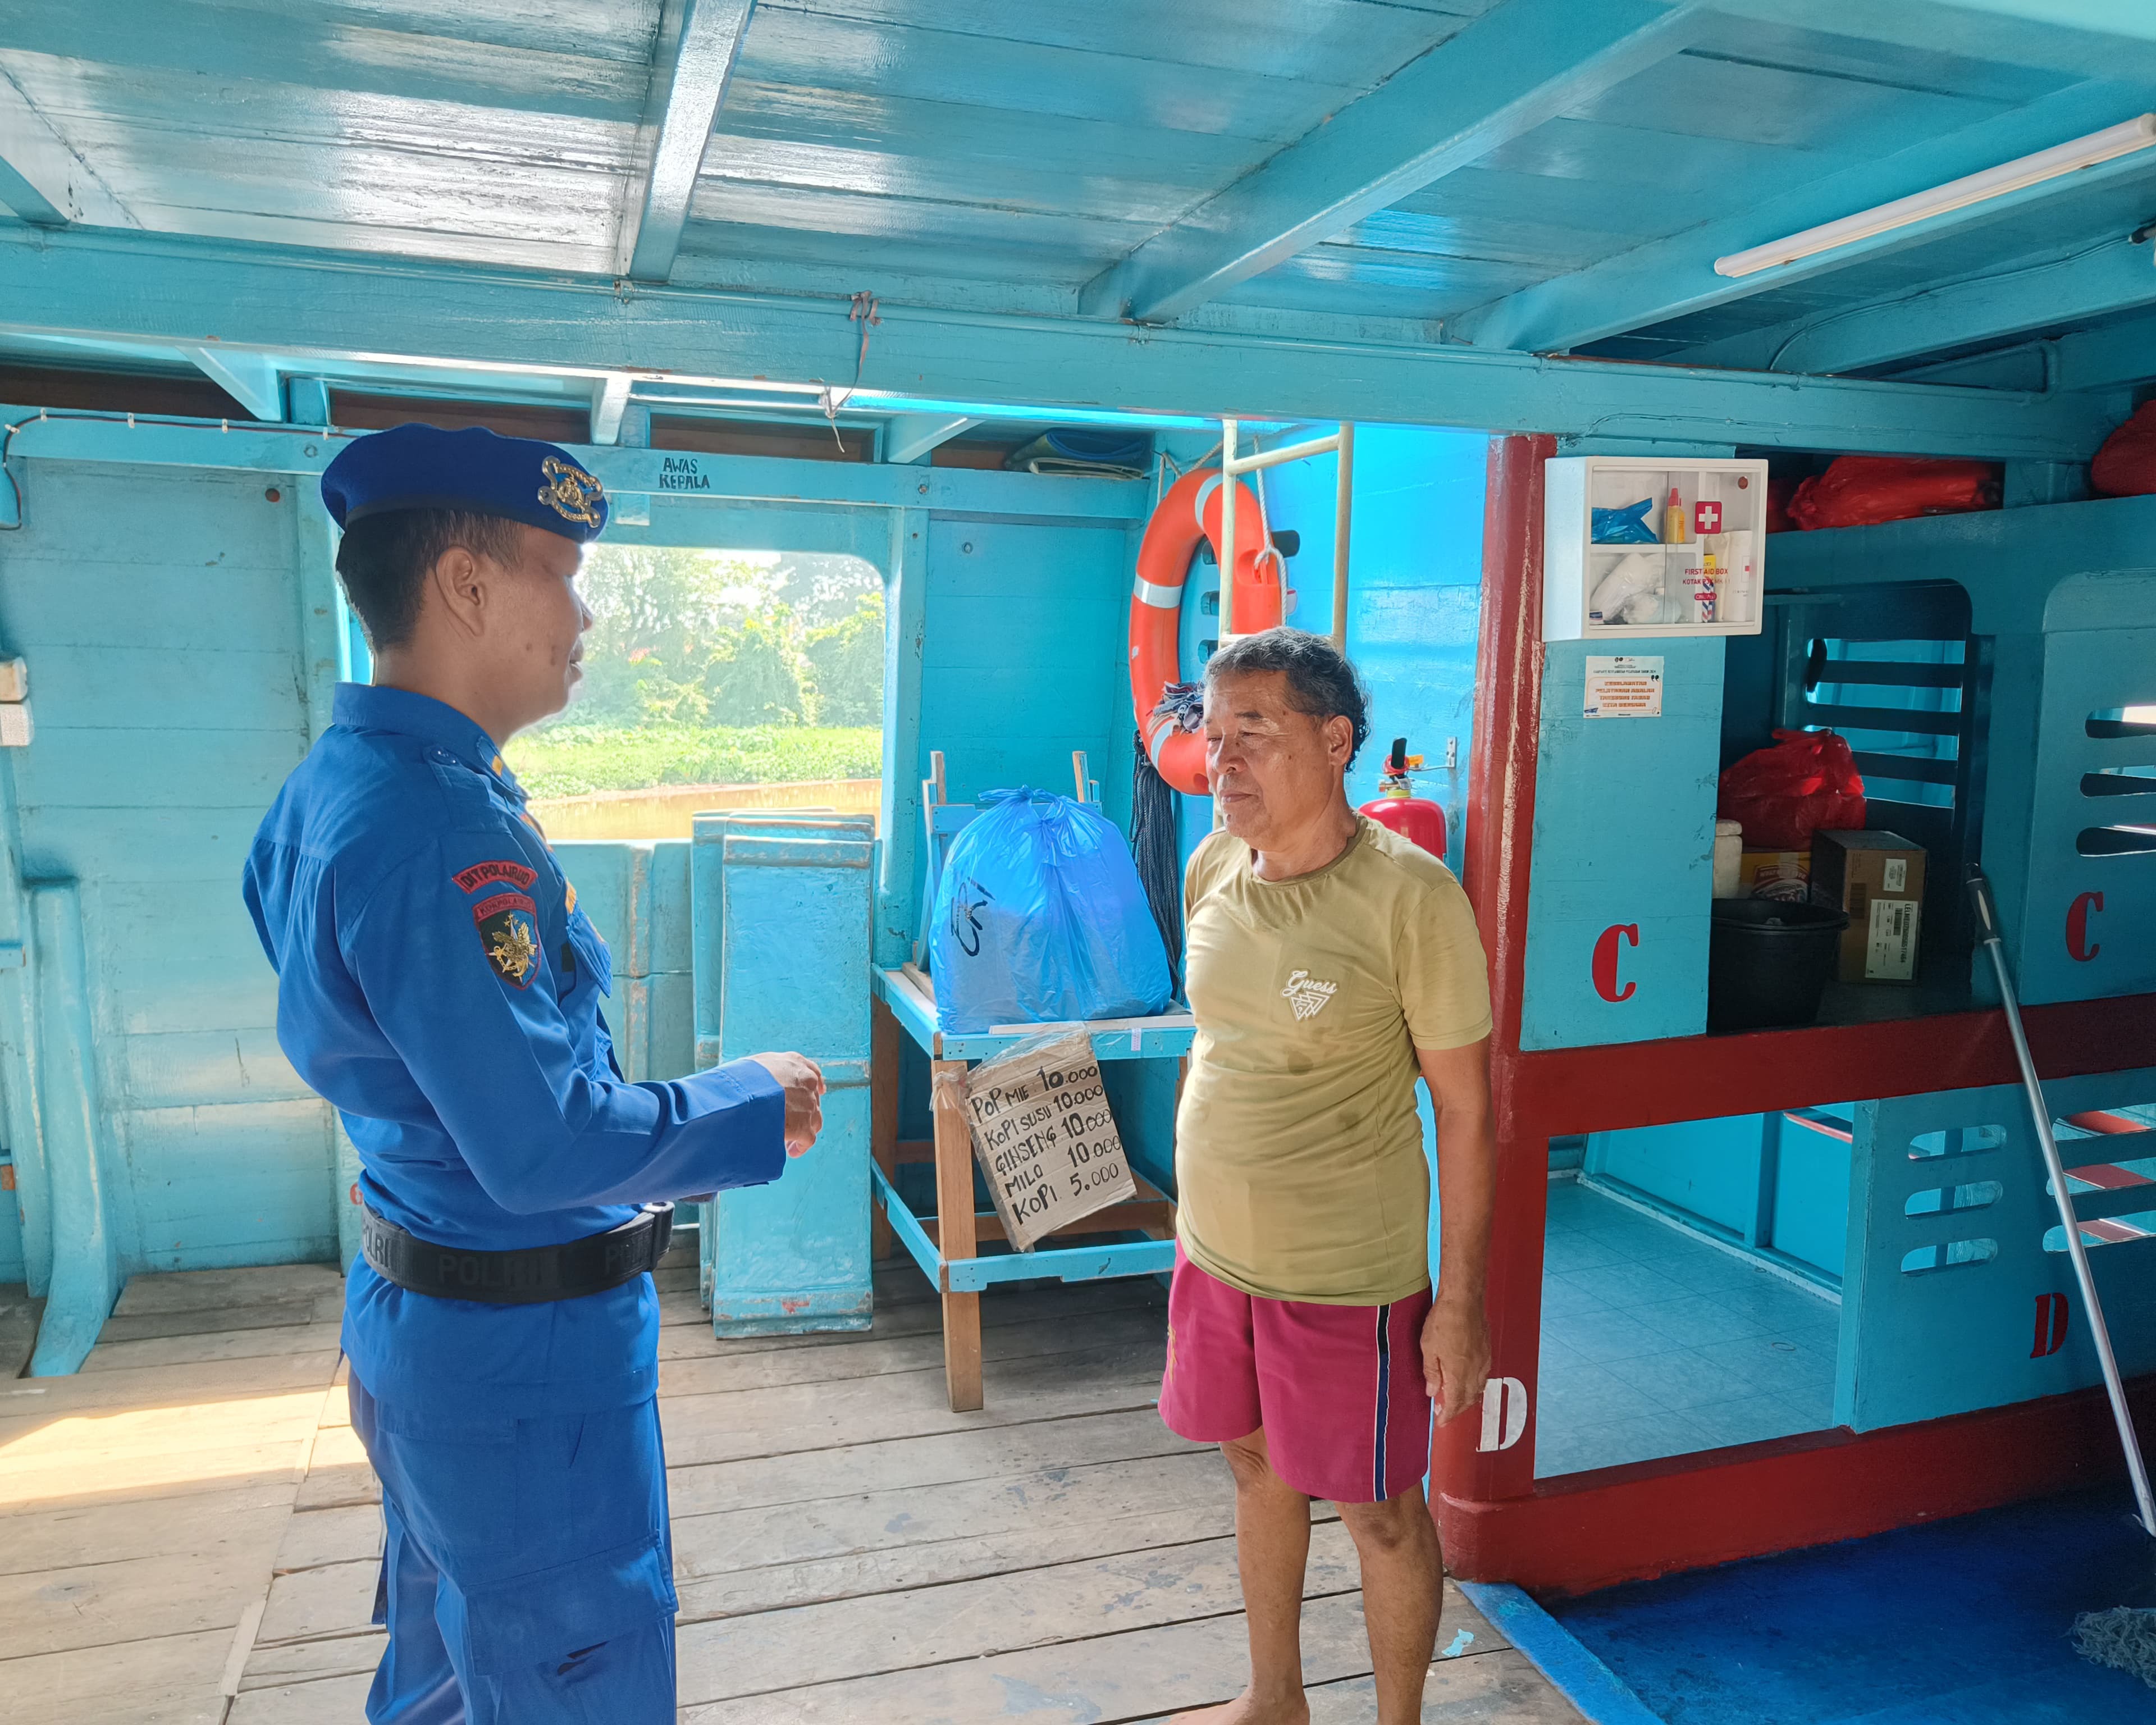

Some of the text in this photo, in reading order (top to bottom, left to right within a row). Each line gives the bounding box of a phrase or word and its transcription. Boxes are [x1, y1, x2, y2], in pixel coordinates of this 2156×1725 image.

[659, 473, 710, 490] KEPALA
[663, 457, 698, 474] AWAS
[2066, 891, 2104, 962] C
[1282, 970, 1337, 997] Guess
[1592, 923, 1639, 1003] C
[970, 1066, 1099, 1124] POP MIE 10.000
[984, 1084, 1103, 1151] KOPI SUSU 10.000
[995, 1125, 1057, 1176] GINSENG
[1004, 1135, 1121, 1198] MILO 10.000
[1012, 1163, 1118, 1225] KOPI 5.000
[363, 1224, 389, 1268] OLRI
[2030, 1292, 2069, 1359] D
[1476, 1377, 1527, 1453] D
